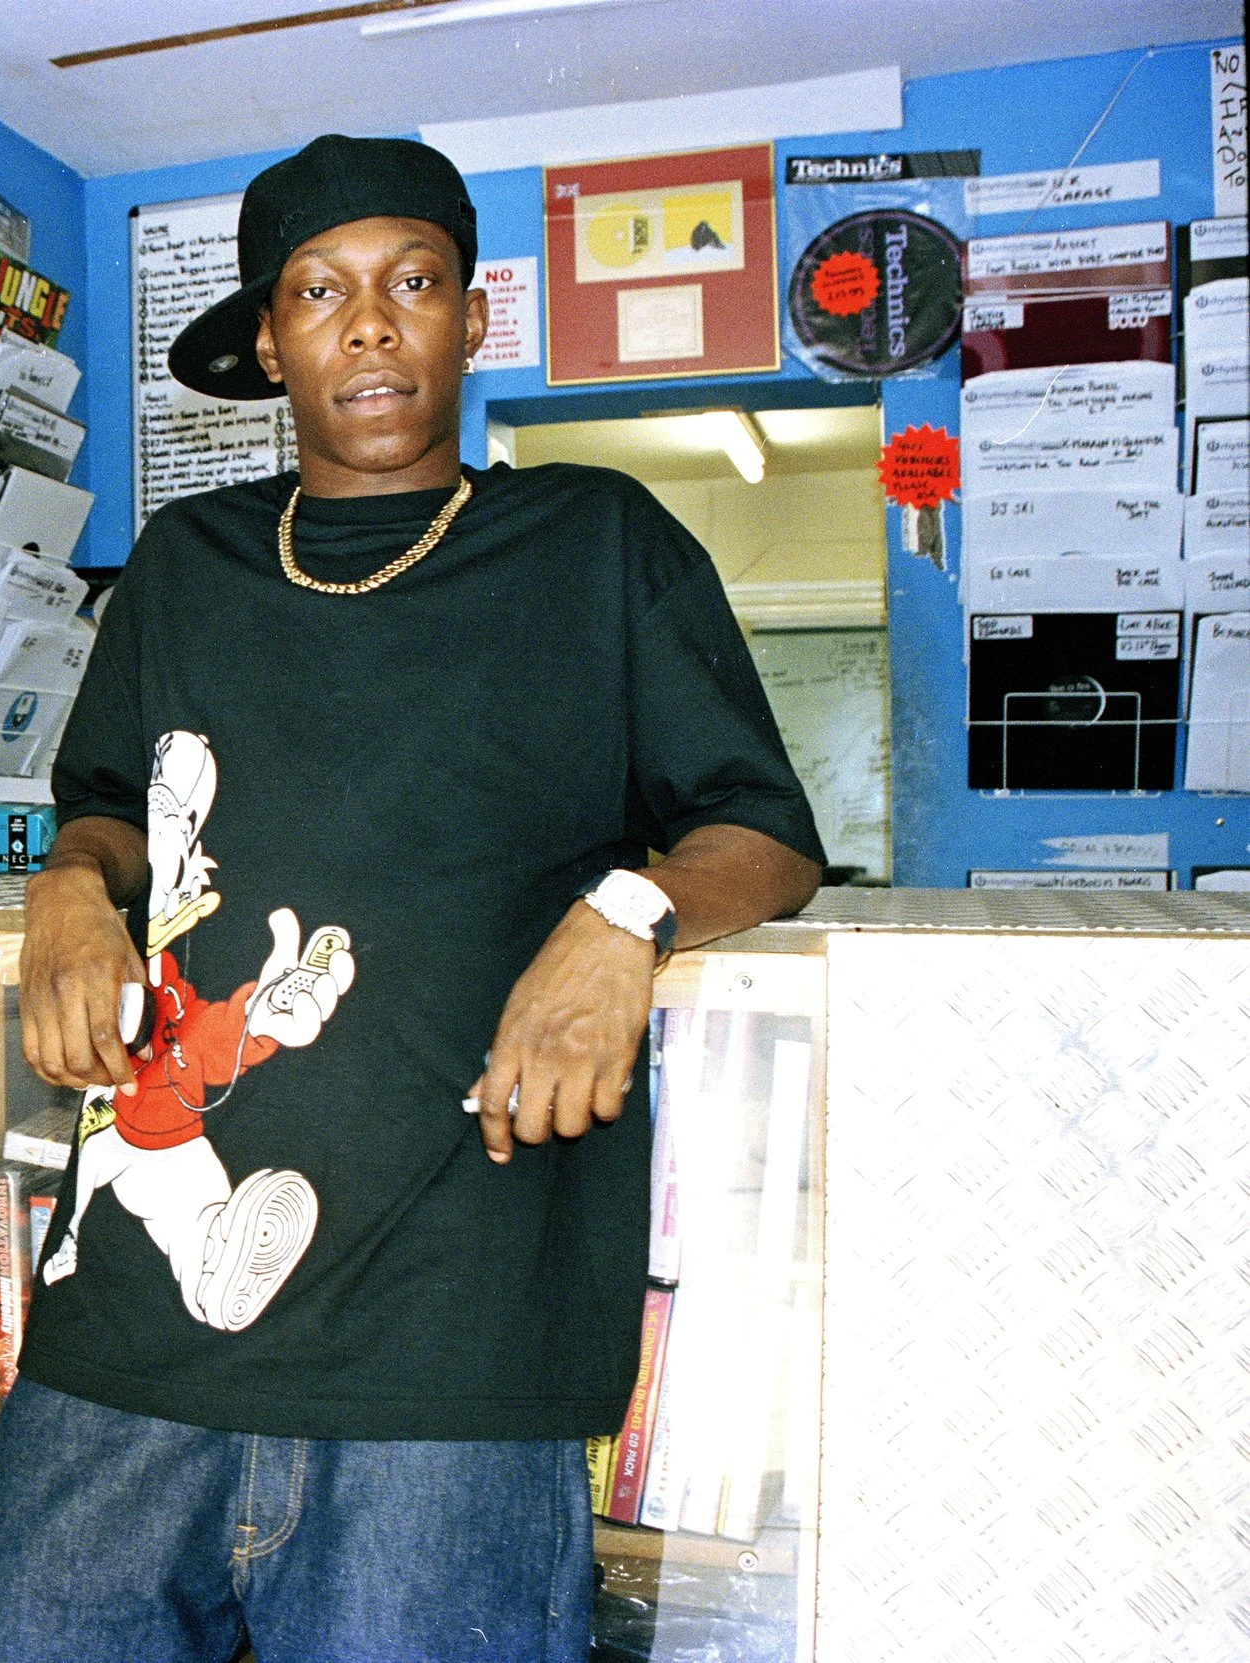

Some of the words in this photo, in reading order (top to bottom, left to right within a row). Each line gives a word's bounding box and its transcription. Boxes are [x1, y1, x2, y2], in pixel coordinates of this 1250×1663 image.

[1215, 55, 1239, 74] NO
[792, 155, 902, 178] Technics
[485, 269, 513, 284] NO
[885, 224, 907, 358] Technics
[636, 1327, 655, 1387] CONVENTION
[628, 1432, 639, 1448] CD
[622, 1448, 638, 1477] PACK
